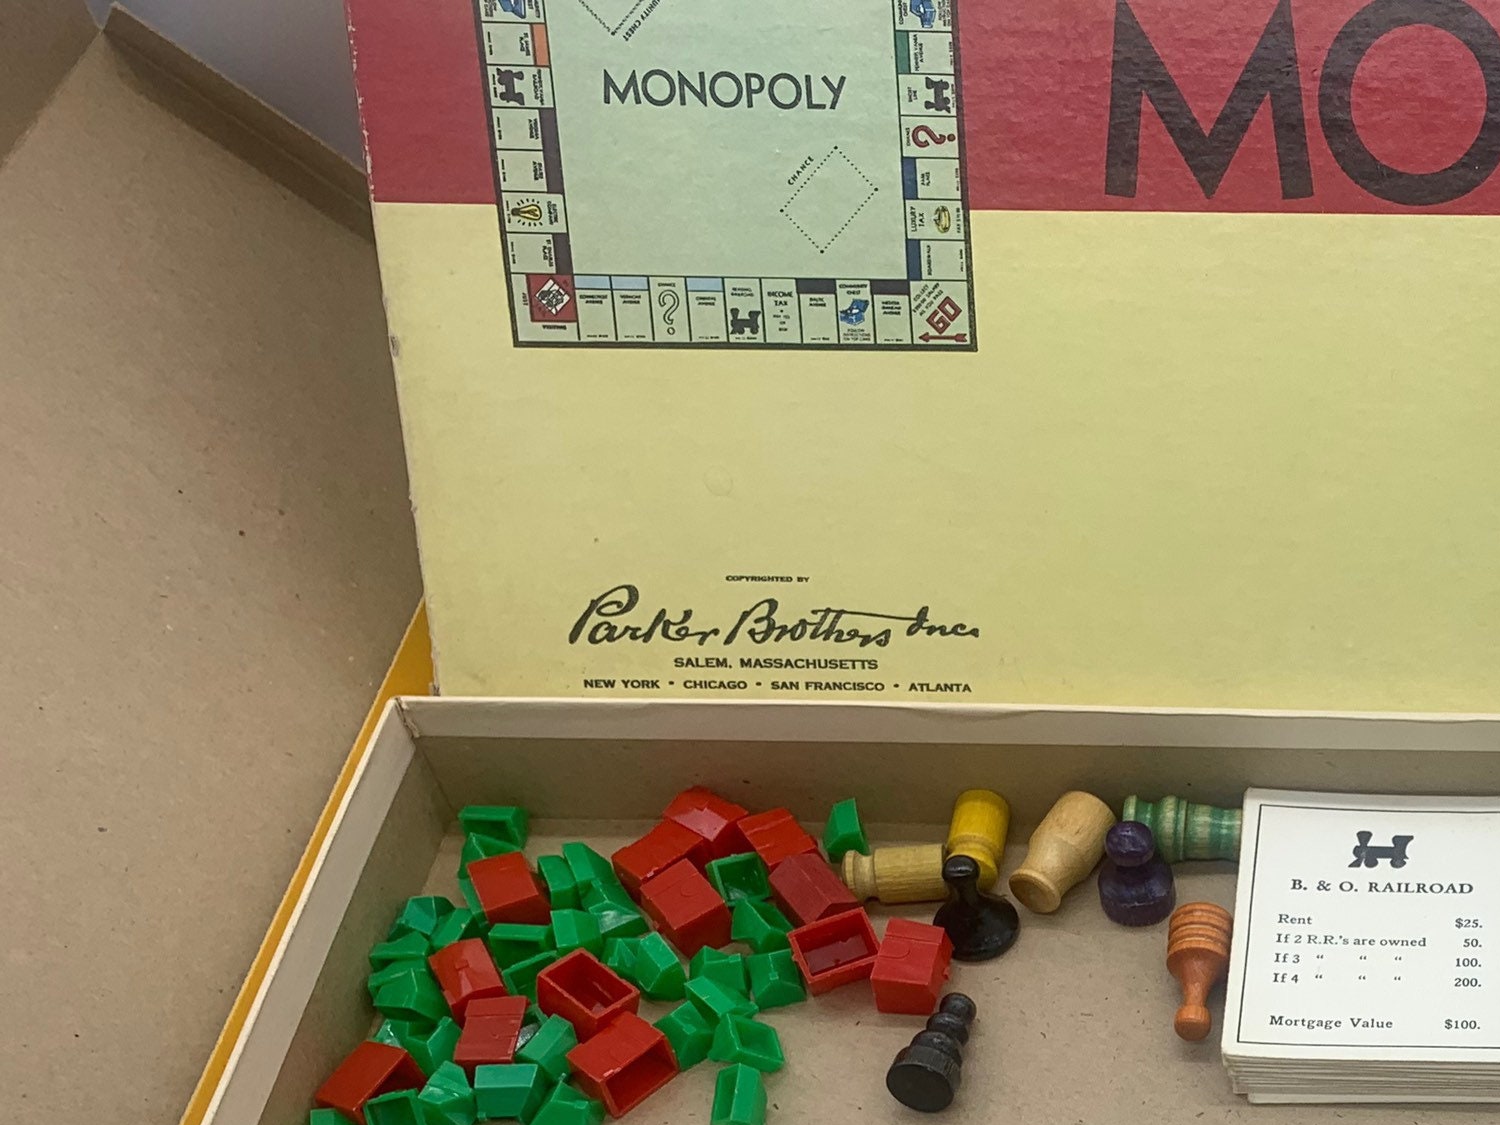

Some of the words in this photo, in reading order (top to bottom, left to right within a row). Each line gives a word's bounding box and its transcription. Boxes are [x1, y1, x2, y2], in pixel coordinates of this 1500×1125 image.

[602, 69, 847, 110] MONOPOLY
[787, 156, 814, 185] CHANCE
[925, 295, 963, 335] GO
[725, 574, 795, 583] COPYRIGHTED
[797, 575, 810, 583] BY
[568, 583, 721, 645] Parker
[723, 598, 893, 647] Brothers
[739, 657, 879, 670] MASSACHUSETTS
[583, 679, 616, 689] NEW
[620, 679, 661, 690] YORK
[683, 680, 748, 690] CHICAGO
[770, 681, 800, 691] SAN
[805, 681, 885, 692] FRANCISCO
[908, 682, 972, 693] ATLANTA
[1291, 879, 1308, 891] B.
[1316, 880, 1331, 892] &
[1339, 881, 1358, 893] O.
[1368, 882, 1474, 894] RAILROAD
[1278, 914, 1313, 925] Rent
[1455, 918, 1483, 929] $25.
[1276, 933, 1291, 944] If
[1294, 935, 1302, 944] 2
[1353, 937, 1376, 947] are
[1380, 937, 1427, 947] owned
[1463, 938, 1482, 948] 50.
[1274, 953, 1289, 963] If
[1292, 954, 1300, 964] 3
[1455, 957, 1482, 968] 100.
[1273, 973, 1288, 983] If
[1291, 973, 1299, 984] 4
[1454, 977, 1482, 988] 200.
[1269, 1015, 1342, 1029] Mortgage
[1350, 1017, 1394, 1029] Value
[1444, 1019, 1481, 1030] $100.
